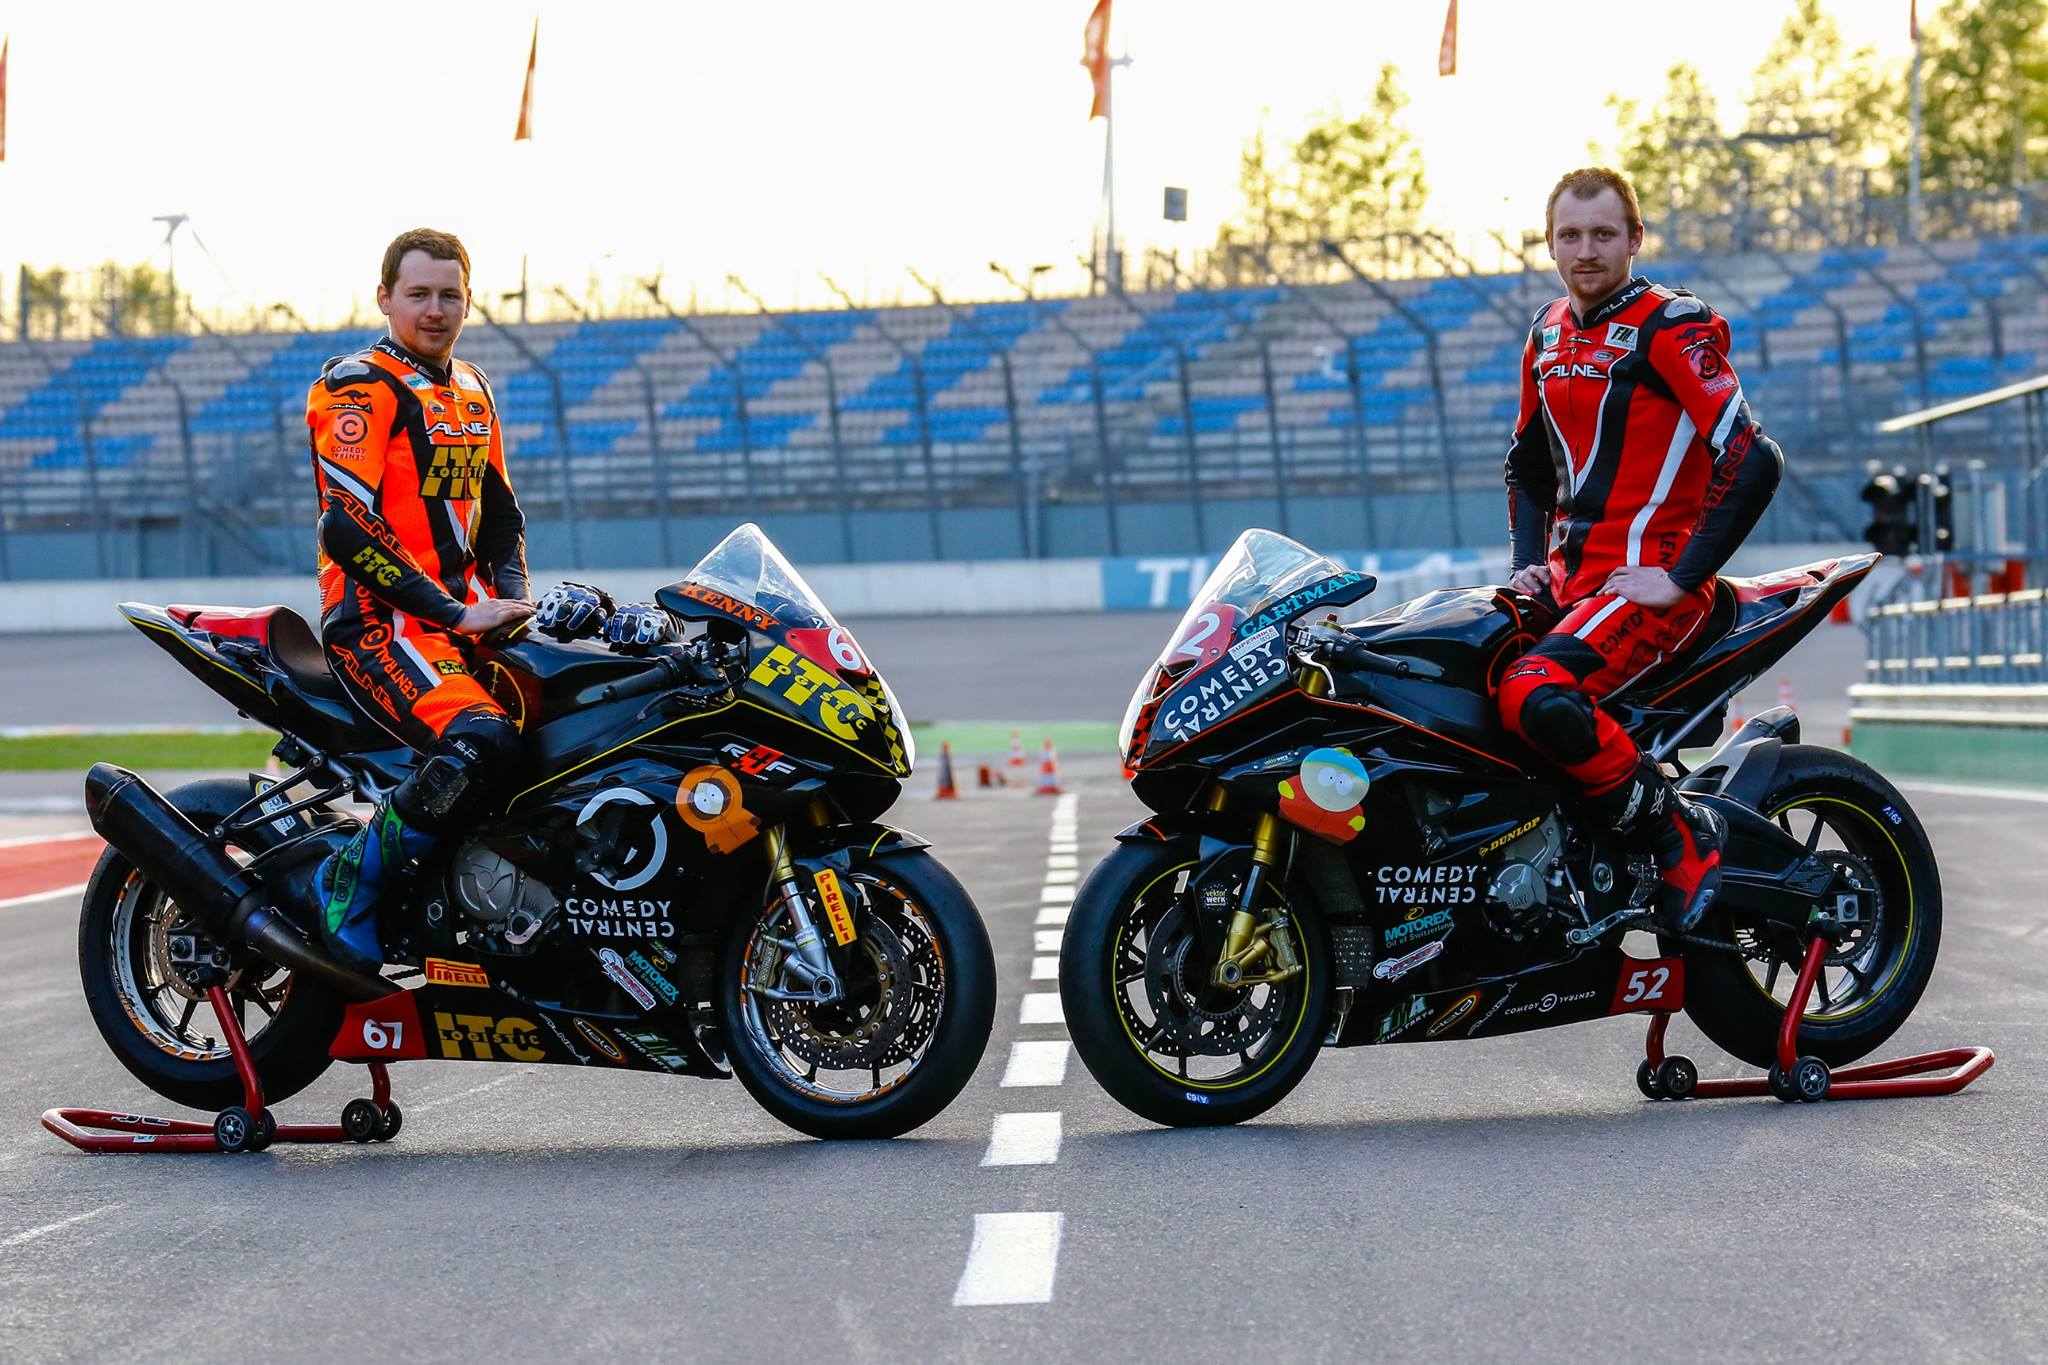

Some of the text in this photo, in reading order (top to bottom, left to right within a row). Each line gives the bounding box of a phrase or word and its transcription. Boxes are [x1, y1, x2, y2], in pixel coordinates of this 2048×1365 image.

[1542, 363, 1608, 379] ALNE
[678, 584, 780, 630] KENNY
[1240, 571, 1362, 638] CARTMAN
[1164, 641, 1273, 729] COMEDY
[1173, 659, 1286, 743] CENTRAL
[1489, 816, 1541, 851] DUNLOP
[1377, 865, 1479, 883] COMEDY
[565, 898, 671, 918] COMEDY
[818, 873, 850, 942] PIRELLI
[1375, 887, 1477, 904] CENTRAL
[567, 918, 675, 938] CENTRAL
[1384, 907, 1453, 942] MOTOREX
[427, 960, 488, 985] PIRELLI
[628, 949, 680, 1001] MOTOREX
[1622, 967, 1670, 1003] 52
[1504, 1002, 1540, 1015] COMEDY
[362, 1019, 403, 1051] 67
